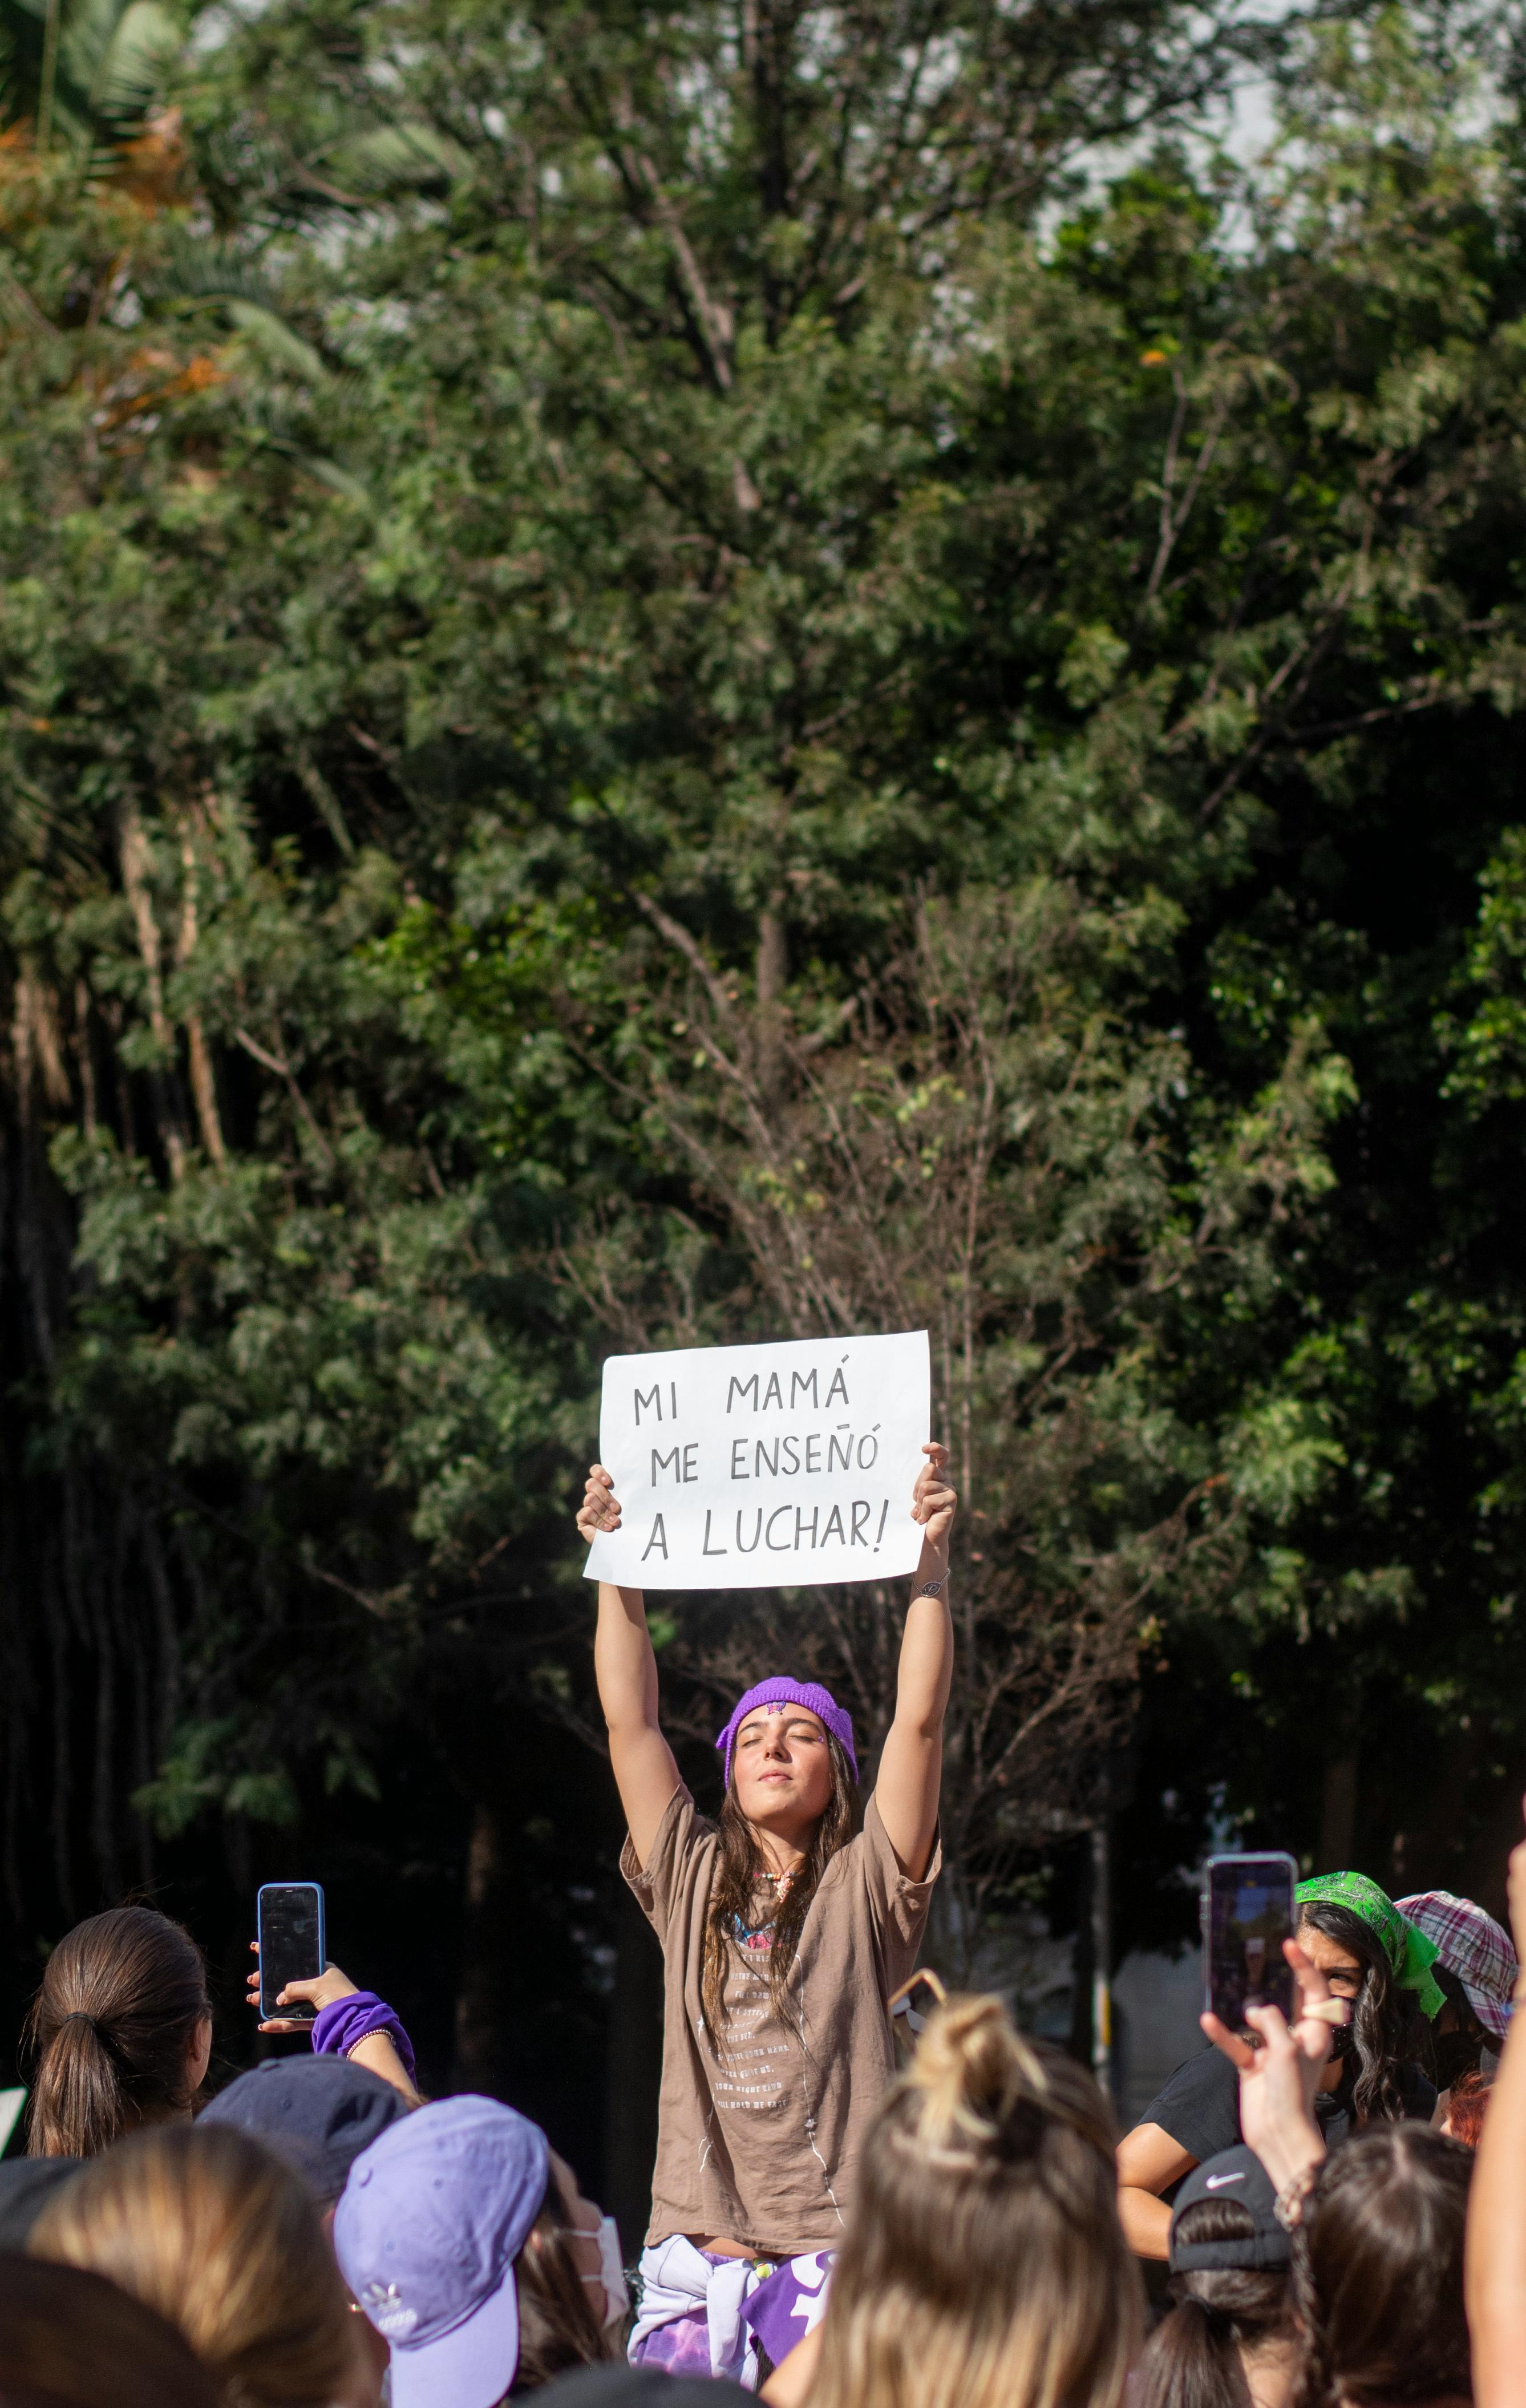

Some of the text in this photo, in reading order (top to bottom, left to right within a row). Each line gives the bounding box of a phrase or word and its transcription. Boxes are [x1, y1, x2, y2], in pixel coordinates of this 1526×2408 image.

[634, 1354, 849, 1426] MI MAMÁ
[651, 1423, 881, 1488] ME ENSEÑÓ
[641, 1499, 889, 1561] A LUCHAR!
[730, 2100, 751, 2109] HOLD
[735, 2085, 761, 2094] RIGHT
